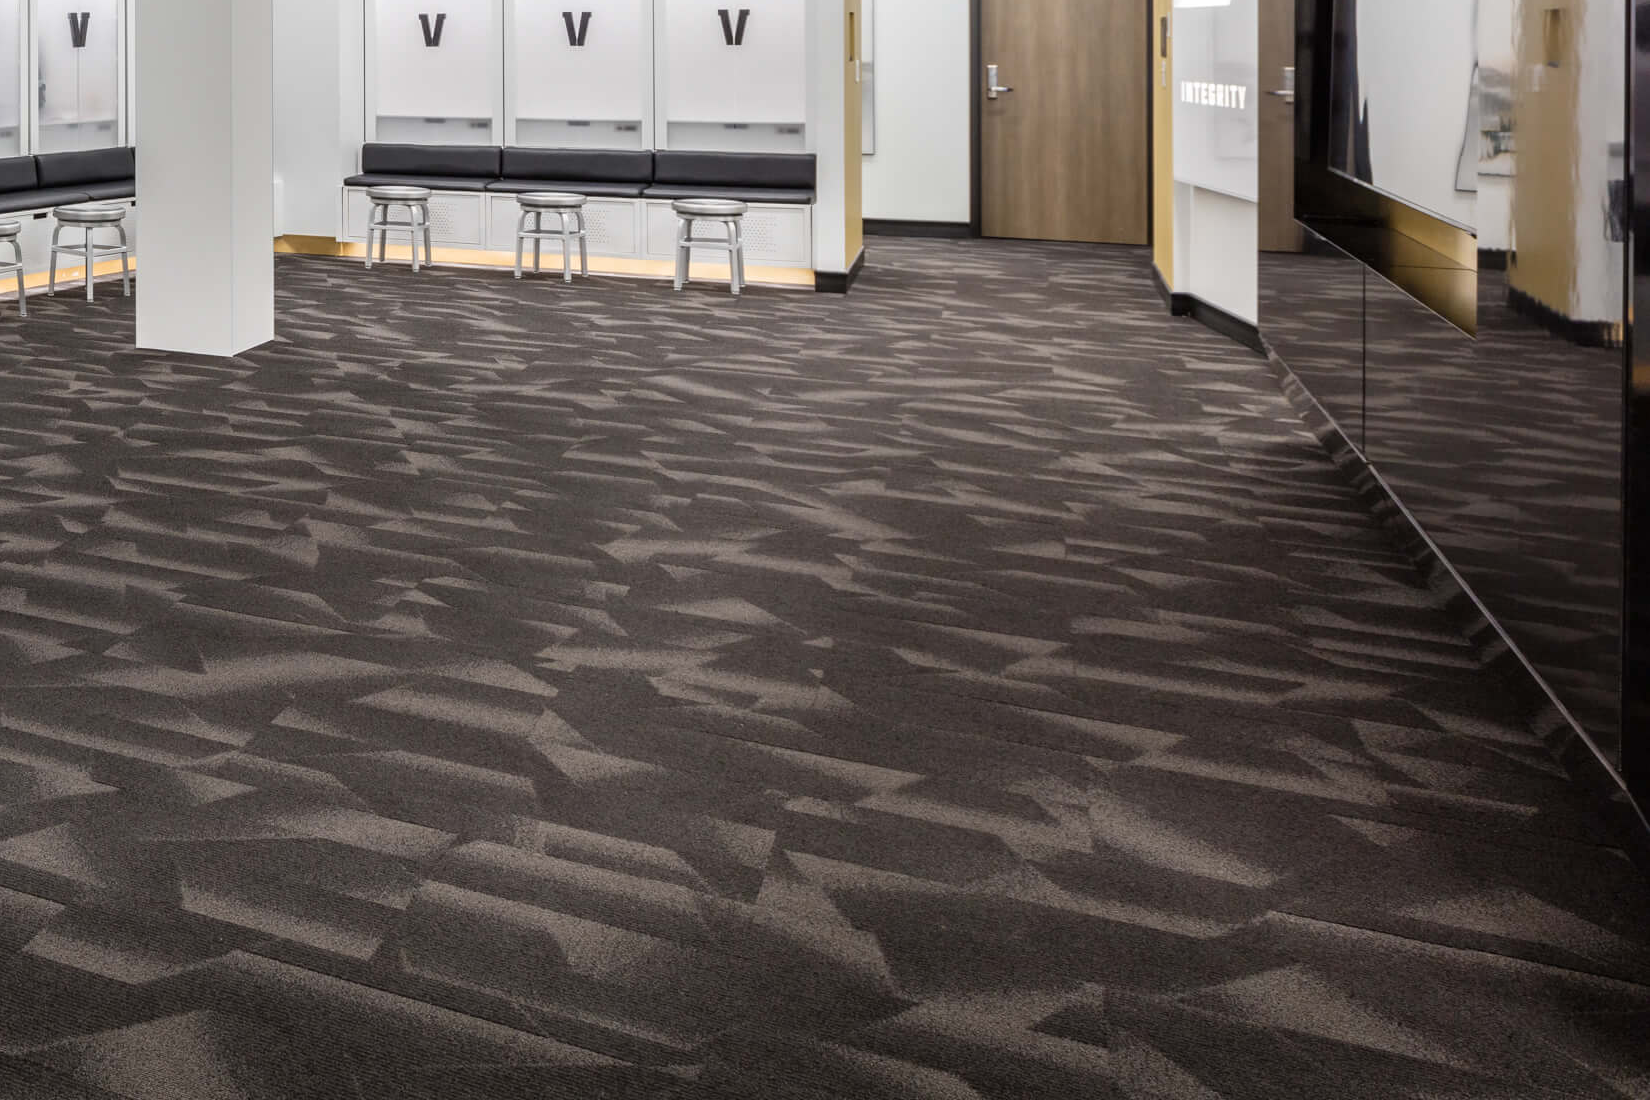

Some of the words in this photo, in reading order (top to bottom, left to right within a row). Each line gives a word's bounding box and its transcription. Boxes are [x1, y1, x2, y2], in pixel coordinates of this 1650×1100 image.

[68, 12, 90, 47] V
[418, 13, 446, 47] V
[562, 11, 592, 46] V
[718, 9, 750, 46] V
[1181, 80, 1247, 110] INTEGRITY
